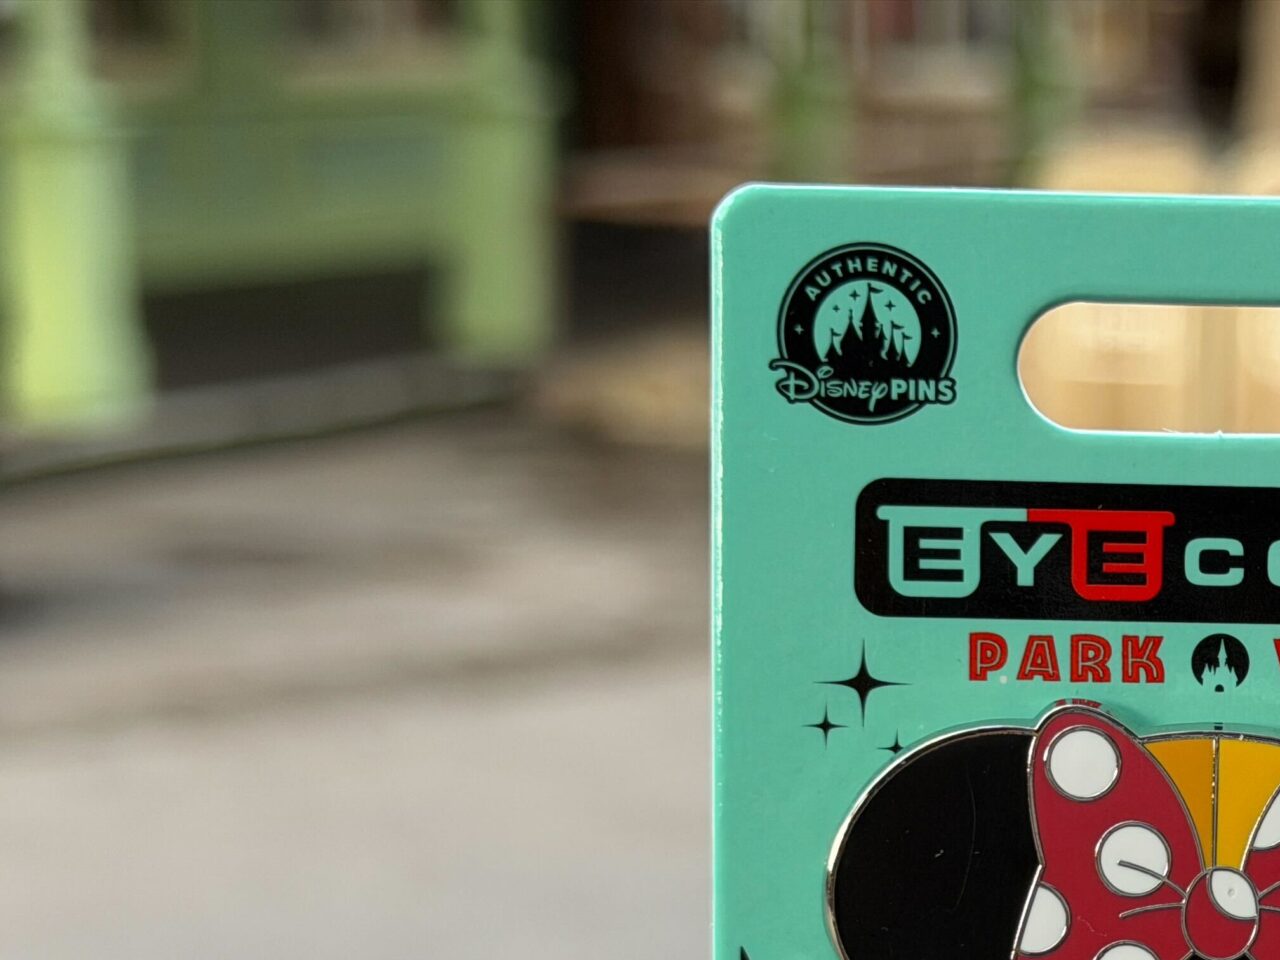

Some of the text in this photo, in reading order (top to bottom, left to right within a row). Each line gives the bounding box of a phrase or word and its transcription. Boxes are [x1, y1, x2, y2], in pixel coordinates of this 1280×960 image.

[804, 257, 932, 305] AUTHENTIC
[890, 379, 954, 401] PINS
[968, 631, 1166, 684] PARK
